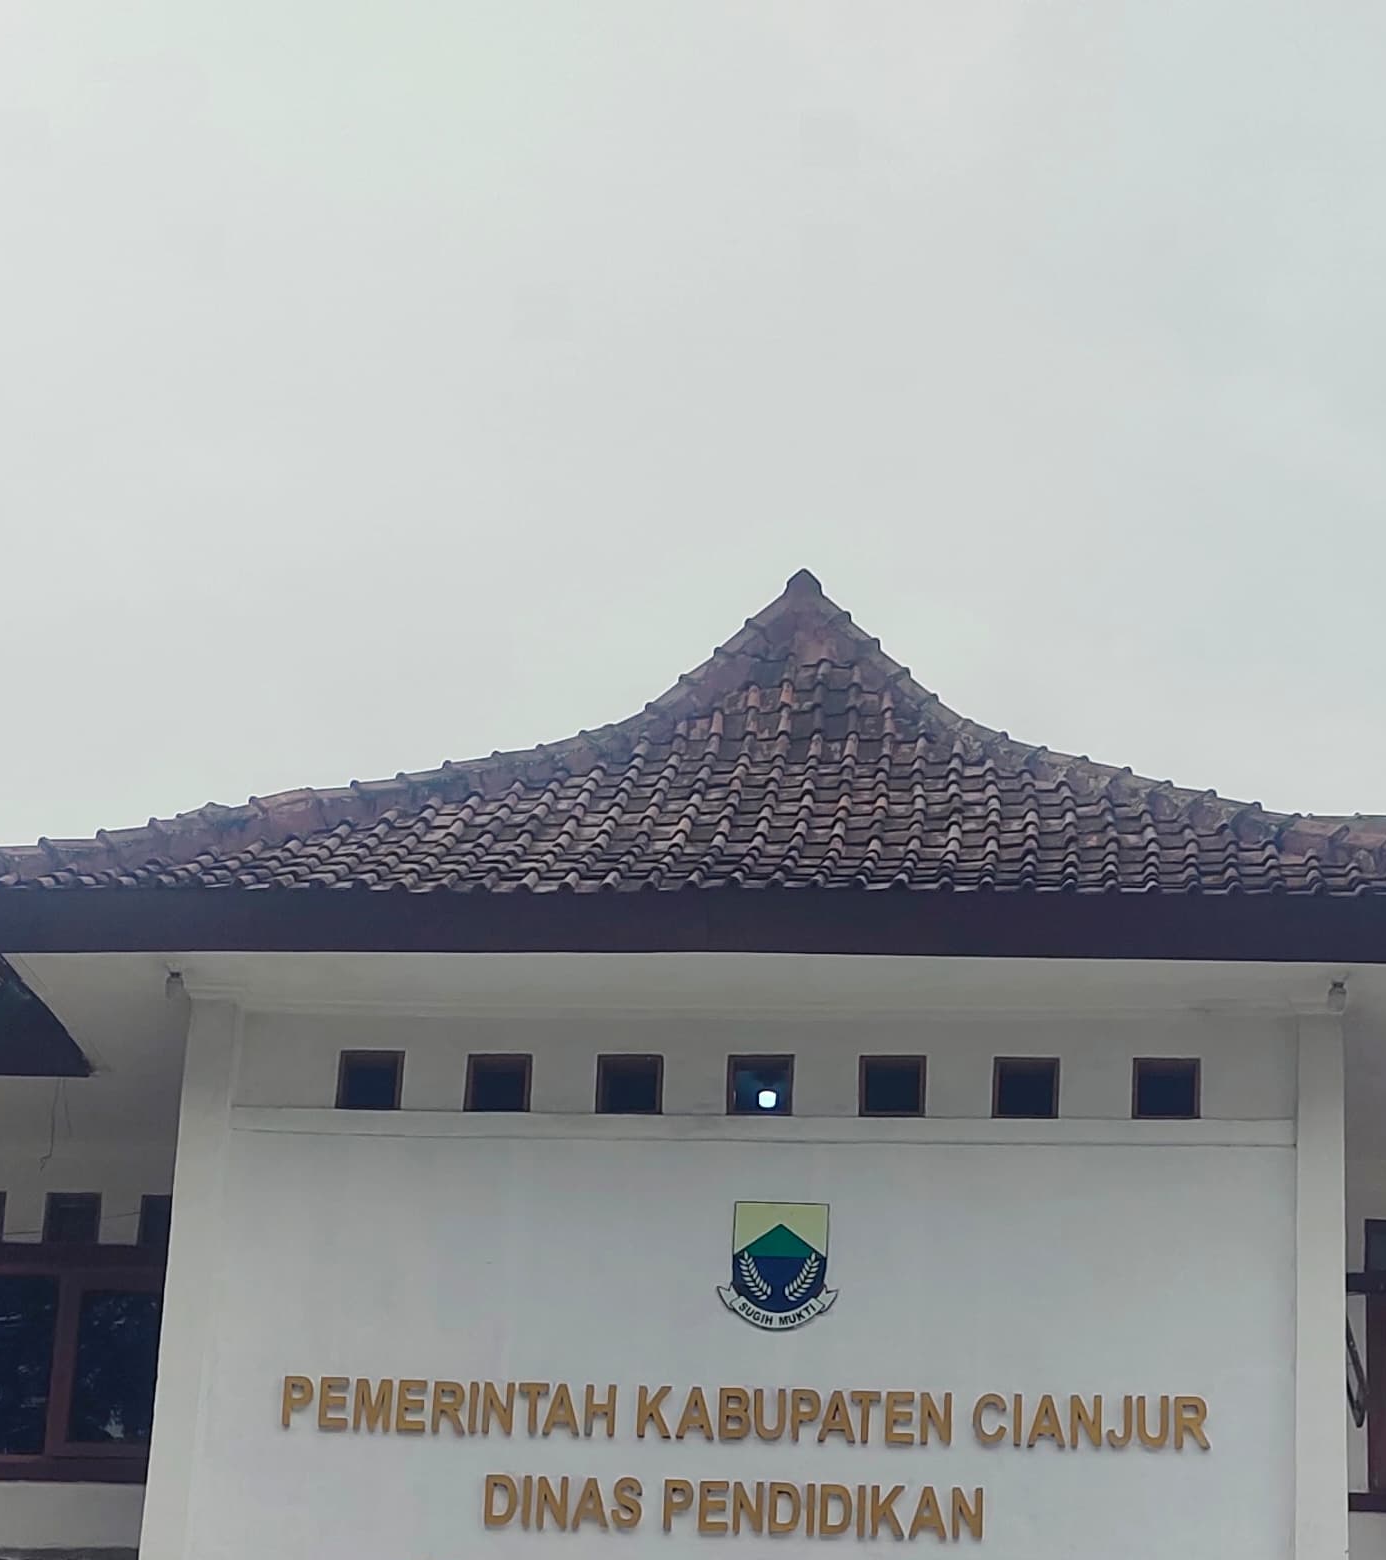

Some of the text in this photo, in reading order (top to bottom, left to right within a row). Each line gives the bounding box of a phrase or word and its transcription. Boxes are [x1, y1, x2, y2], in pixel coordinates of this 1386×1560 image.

[738, 1302, 817, 1326] SUGIH MUKTI
[282, 1376, 1211, 1449] PEMERINTAH KABUPATEN CIANJUR
[485, 1474, 984, 1541] DINAS PENDIDIKAN
